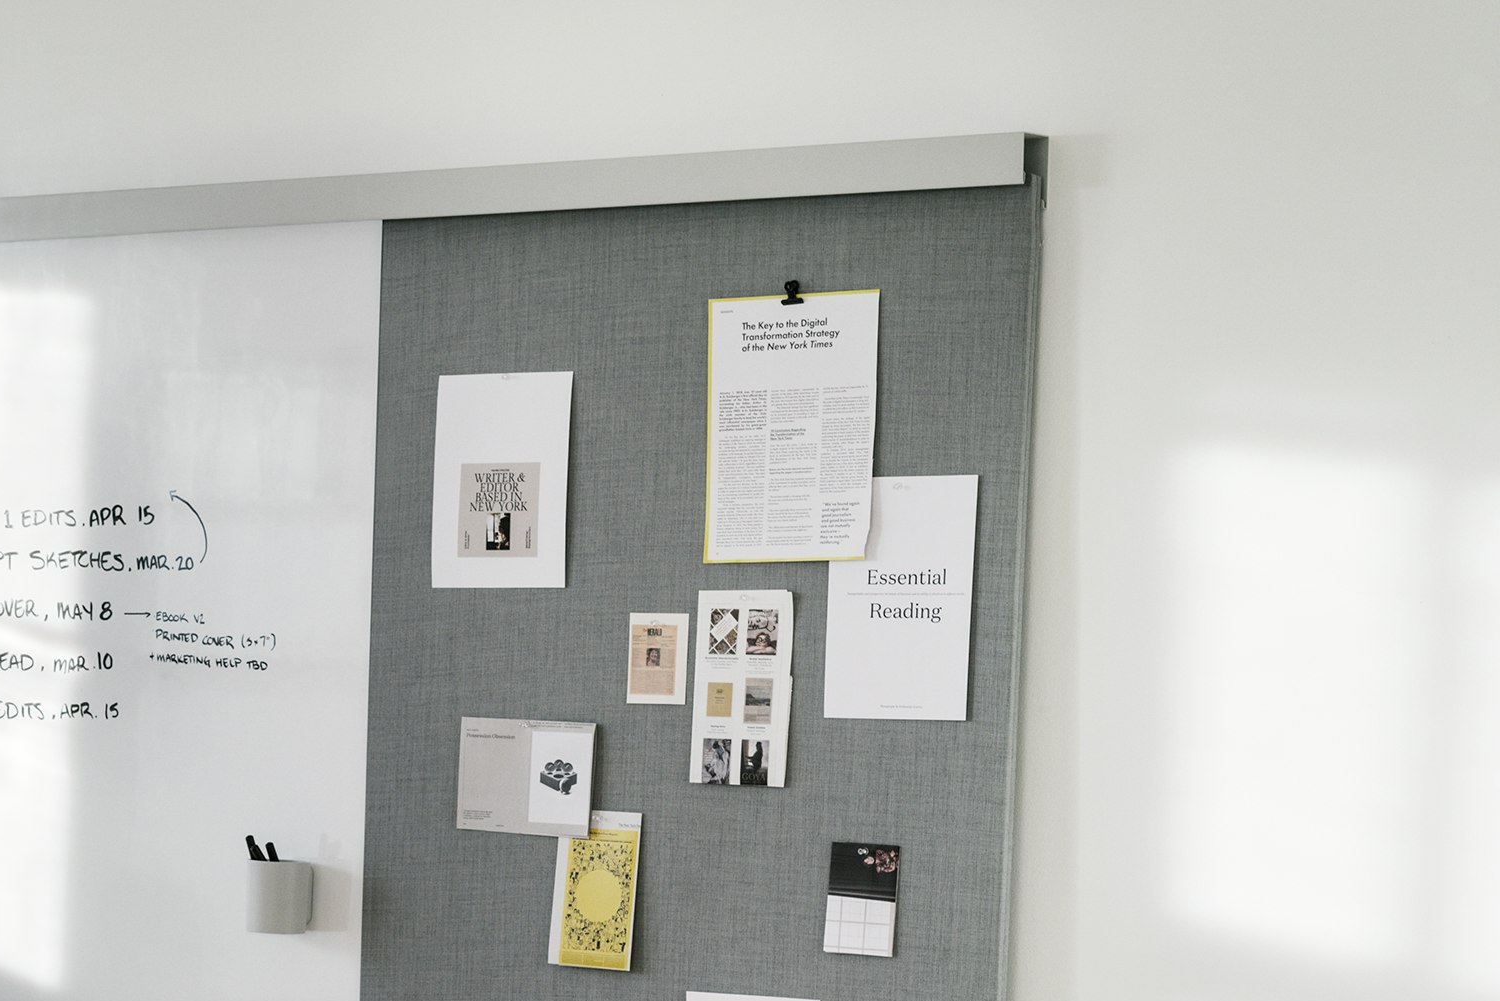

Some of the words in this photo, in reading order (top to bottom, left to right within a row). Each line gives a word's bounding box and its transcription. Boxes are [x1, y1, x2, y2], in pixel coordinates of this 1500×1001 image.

[742, 322, 756, 331] The
[758, 321, 774, 331] Key
[775, 320, 784, 329] to
[786, 319, 799, 328] the
[800, 317, 828, 329] Digital
[742, 329, 804, 342] Transformation
[805, 328, 841, 339] Strategy
[741, 342, 751, 352] of
[752, 342, 765, 351] the
[767, 342, 787, 351] New
[789, 340, 808, 350] York
[810, 340, 833, 349] Times
[474, 472, 515, 483] WRITER
[516, 472, 526, 483] &
[480, 482, 519, 492] EDITOR
[475, 491, 508, 502] BASED
[510, 491, 522, 502] IN
[470, 501, 495, 512] NEW
[498, 501, 528, 512] YORK
[3, 509, 14, 529] 1
[88, 503, 128, 528] APR
[137, 505, 156, 526] 15
[175, 555, 195, 572] 20
[867, 568, 947, 586] Essential
[56, 601, 94, 622] MAY
[98, 600, 114, 622] 8
[155, 610, 190, 624] EBOOK
[870, 602, 942, 623] Reading
[154, 628, 199, 644] PRINTED
[201, 635, 235, 651] COVER
[96, 650, 114, 671] 10
[156, 652, 212, 669] MARKETING
[214, 657, 243, 669] HELP
[245, 659, 269, 672] TBD
[104, 701, 120, 721] 15
